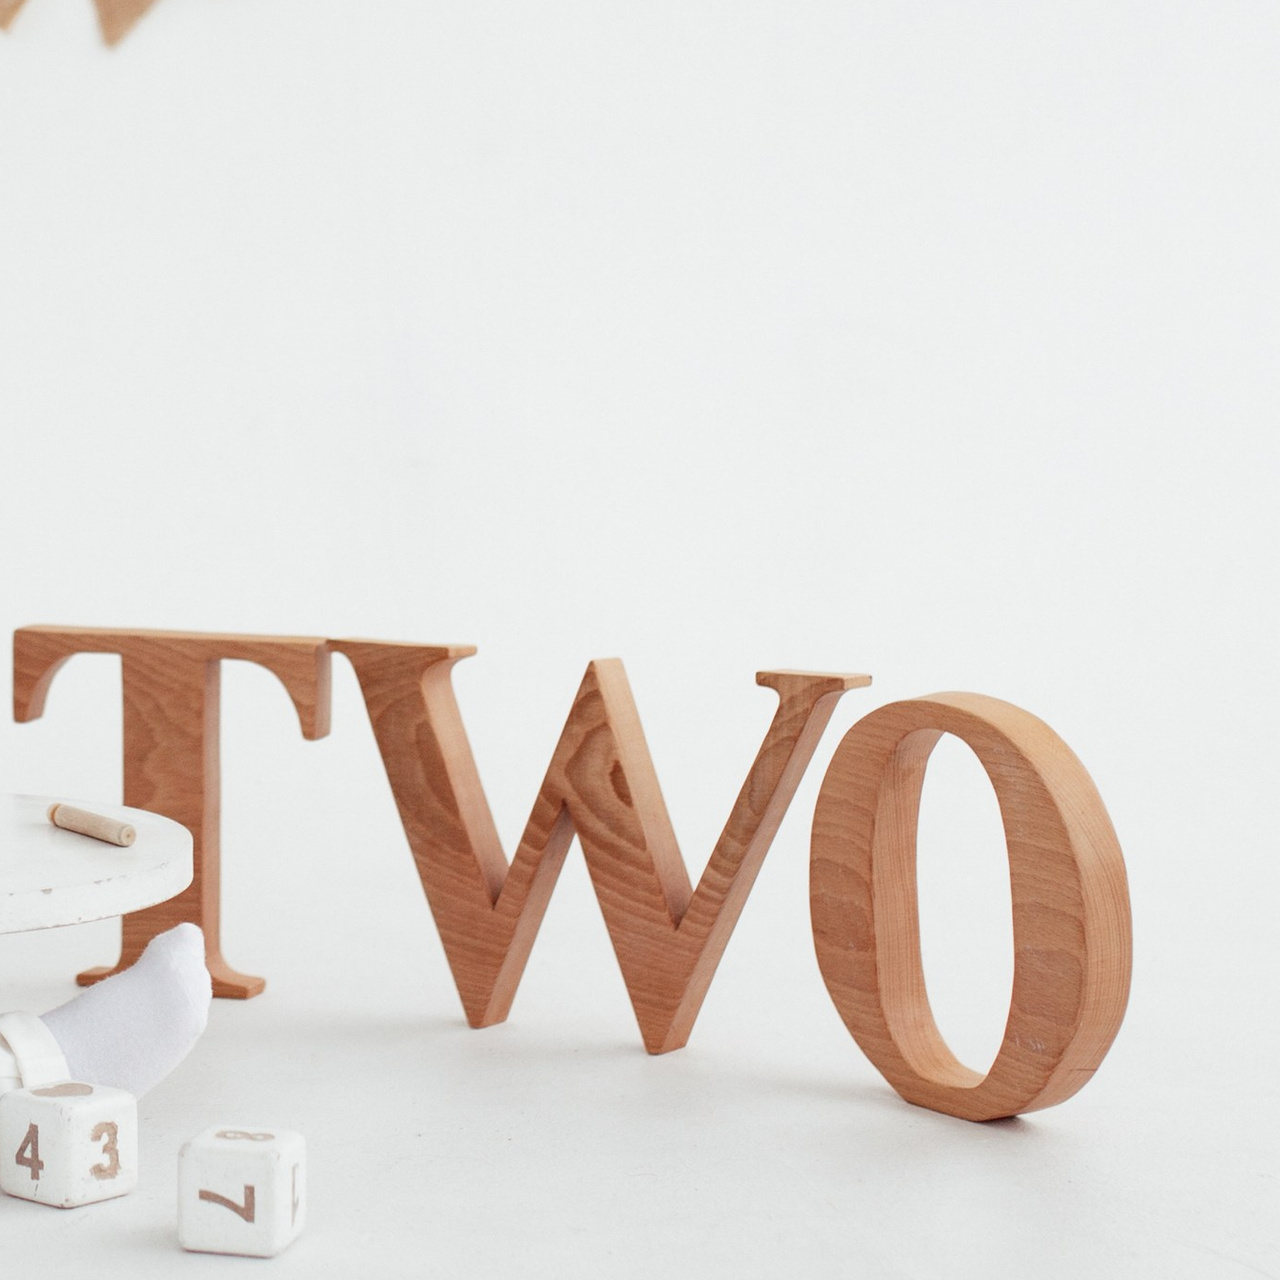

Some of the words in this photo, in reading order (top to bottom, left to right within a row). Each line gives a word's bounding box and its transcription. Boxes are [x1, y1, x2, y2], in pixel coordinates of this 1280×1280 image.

[12, 624, 1133, 1122] TWO
[15, 1122, 44, 1181] 4
[89, 1121, 121, 1181] 3
[198, 1184, 256, 1224] 7
